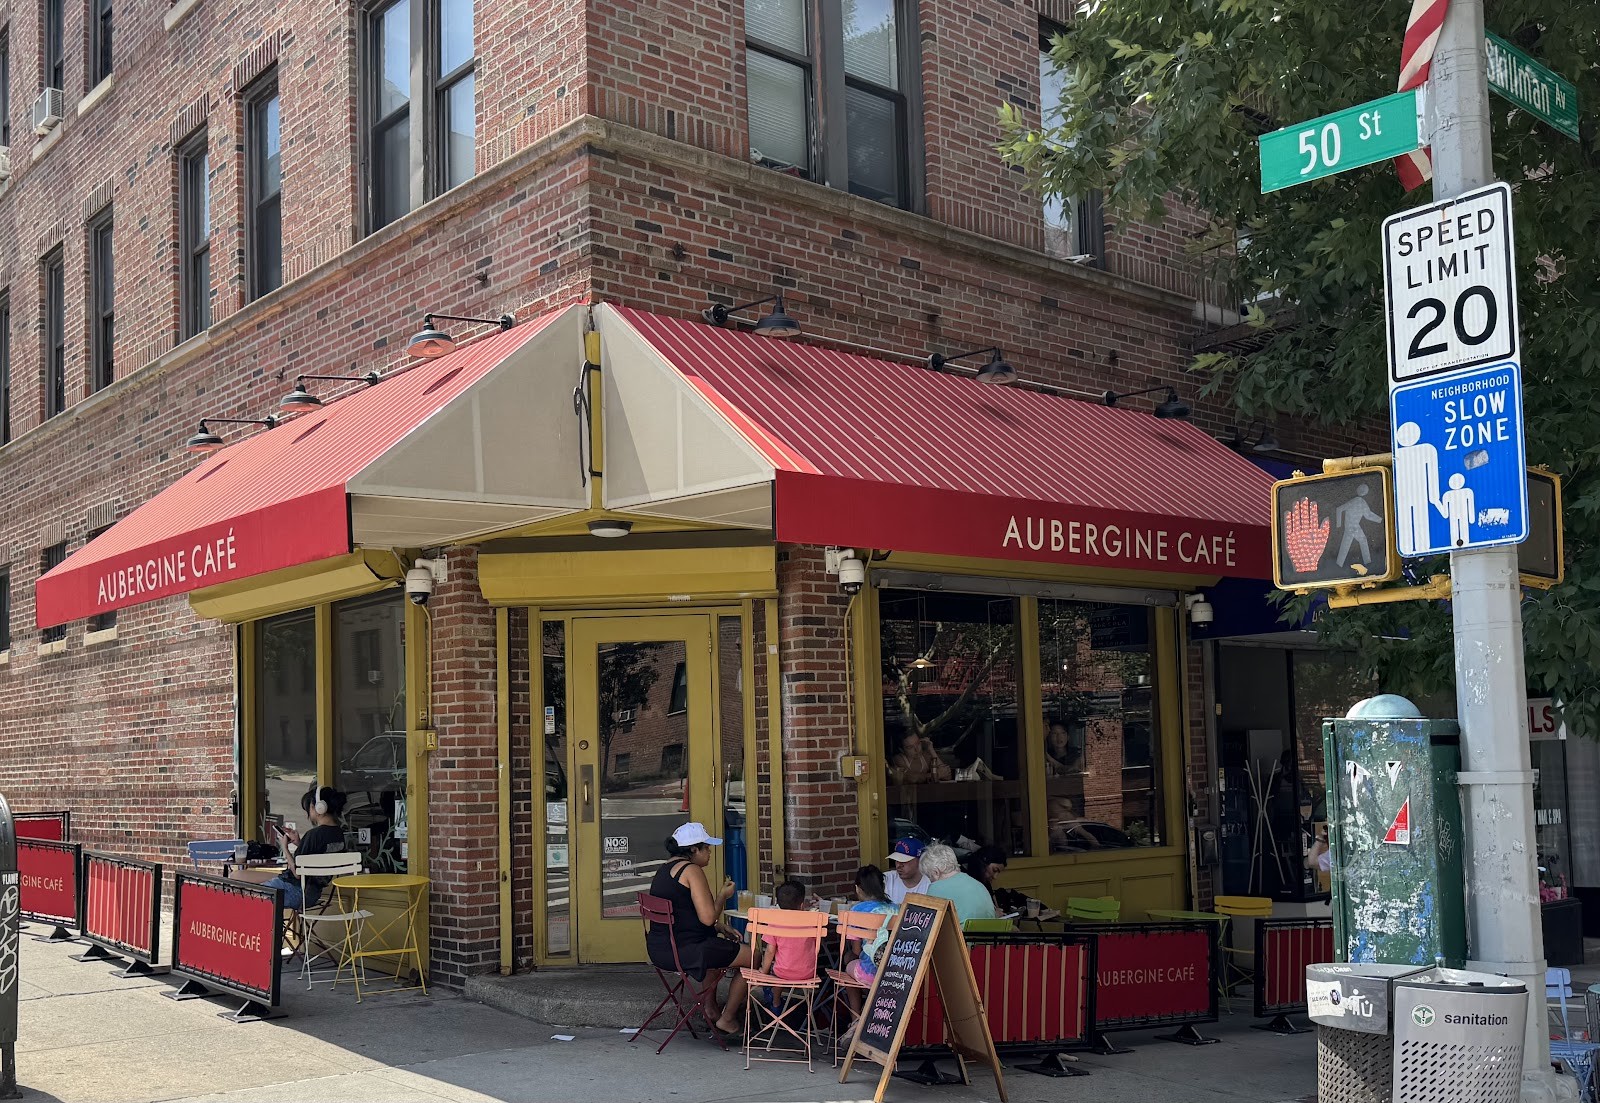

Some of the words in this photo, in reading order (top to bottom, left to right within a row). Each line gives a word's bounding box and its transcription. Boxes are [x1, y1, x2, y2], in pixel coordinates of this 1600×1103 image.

[1484, 37, 1550, 116] Skillman
[1555, 82, 1566, 110] Av
[1299, 122, 1341, 175] 50
[1358, 109, 1382, 140] St
[1397, 208, 1495, 257] SPEED
[1406, 244, 1490, 289] LIMIT
[1406, 285, 1498, 361] 20
[1440, 353, 1489, 367] TRANSPORTATION
[1431, 374, 1510, 400] NEIGHBORHOOD
[1444, 389, 1506, 424] SLOW
[1444, 417, 1510, 451] ZONE
[1002, 515, 1169, 561] AUBERGINE
[1177, 530, 1236, 567] CAFÉ
[97, 550, 186, 606] AUBERGINE
[191, 527, 237, 578] CAFÉ
[1529, 705, 1555, 733] LS
[605, 838, 619, 847] NO
[20, 874, 42, 890] GINE
[43, 876, 64, 892] CAFÉ
[190, 920, 238, 947] AUBERGINE
[239, 932, 261, 953] CAFÉ
[1096, 968, 1164, 988] AUBERGINE
[1167, 963, 1195, 982] CAFÉ
[1444, 1013, 1508, 1026] sanitation
